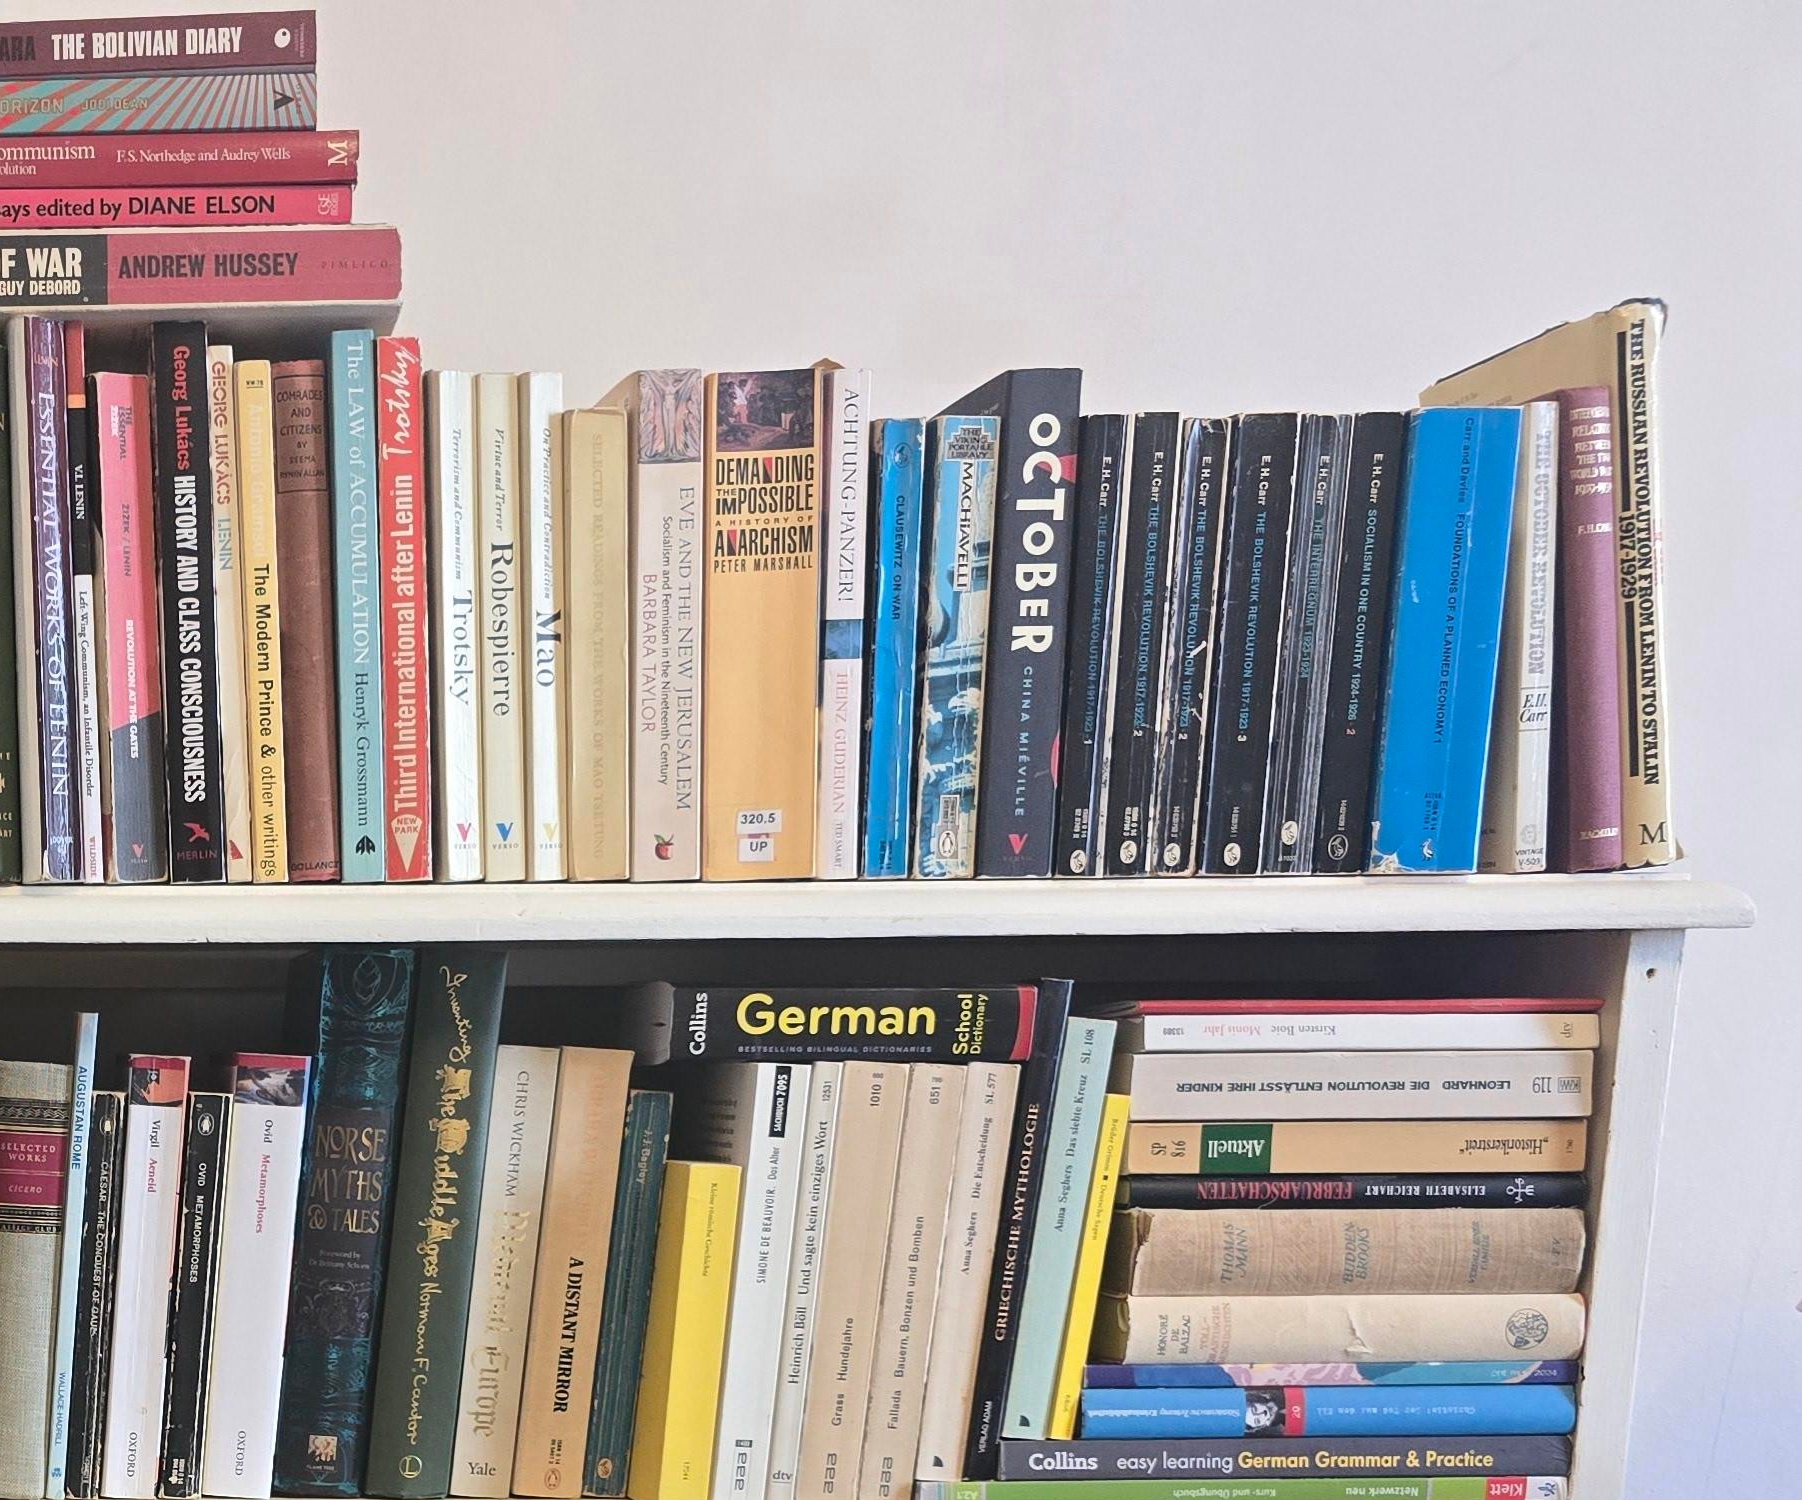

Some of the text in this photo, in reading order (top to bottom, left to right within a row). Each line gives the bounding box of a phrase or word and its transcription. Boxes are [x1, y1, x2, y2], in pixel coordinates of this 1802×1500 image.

[51, 27, 242, 60] THE BOLIVIAN DIARY
[36, 199, 93, 217] edited
[99, 199, 121, 220] by
[128, 198, 196, 216] DIANE
[206, 196, 275, 215] ELSON
[25, 248, 81, 277] WAR
[118, 252, 298, 279] ANDREW HUSSEY
[29, 281, 80, 296] DEBORD
[836, 388, 859, 602] ACHTUNG-PANZER!
[1010, 413, 1066, 653] OCTOBER
[714, 557, 813, 573] PETER MARSHALL
[1617, 512, 1634, 599] 1917-1929
[173, 475, 206, 803] HISTORY AND CLASS CONSCIOUSNESS
[490, 542, 511, 717] Robespierre
[391, 475, 417, 813] Third International after Lenin
[535, 611, 562, 688] Mao
[740, 812, 776, 826] 320.5
[748, 841, 768, 853] UP
[689, 991, 708, 1056] Collins
[736, 992, 936, 1037] German
[1442, 1079, 1511, 1091] LEONHARD
[1207, 1138, 1266, 1160] Aktuell
[1028, 1452, 1098, 1471] Collins
[1116, 1450, 1493, 1474] easy learning German Grammar & Practice
[1490, 1480, 1523, 1496] Klett
